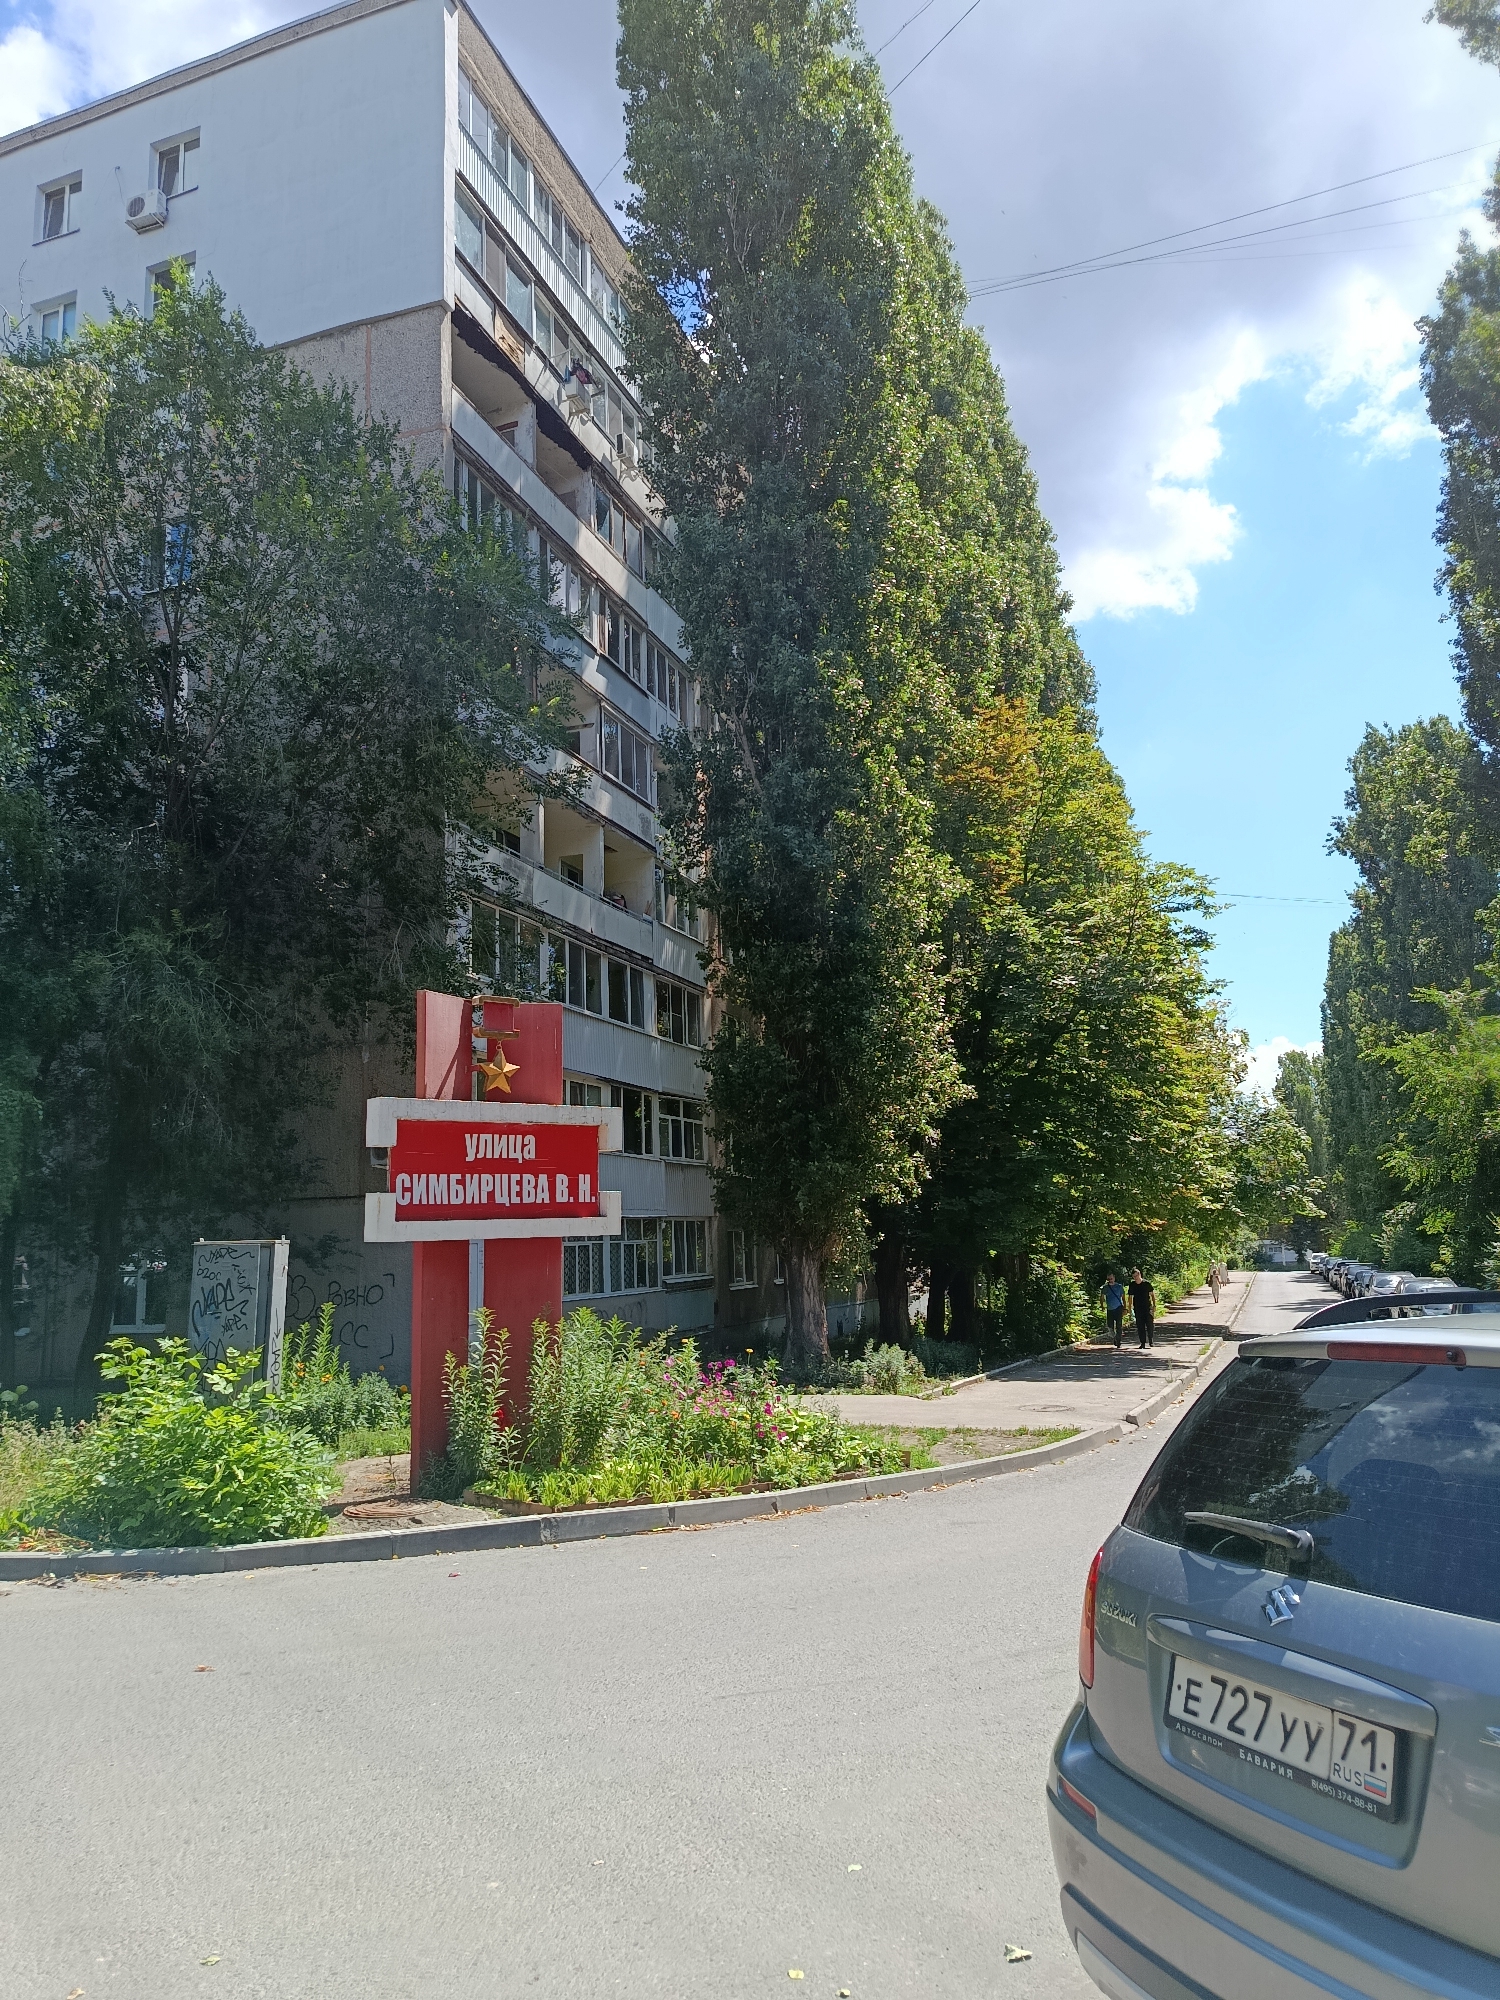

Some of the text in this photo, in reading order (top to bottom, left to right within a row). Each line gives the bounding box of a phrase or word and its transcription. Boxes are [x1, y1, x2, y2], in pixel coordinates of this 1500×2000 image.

[465, 1133, 536, 1163] улица
[395, 1172, 550, 1206] СИМБИРЦЕВА
[1100, 1600, 1138, 1627] SUZUKI
[1239, 1748, 1294, 1779] БАВАРИЯ
[1332, 1763, 1363, 1788] RUS
